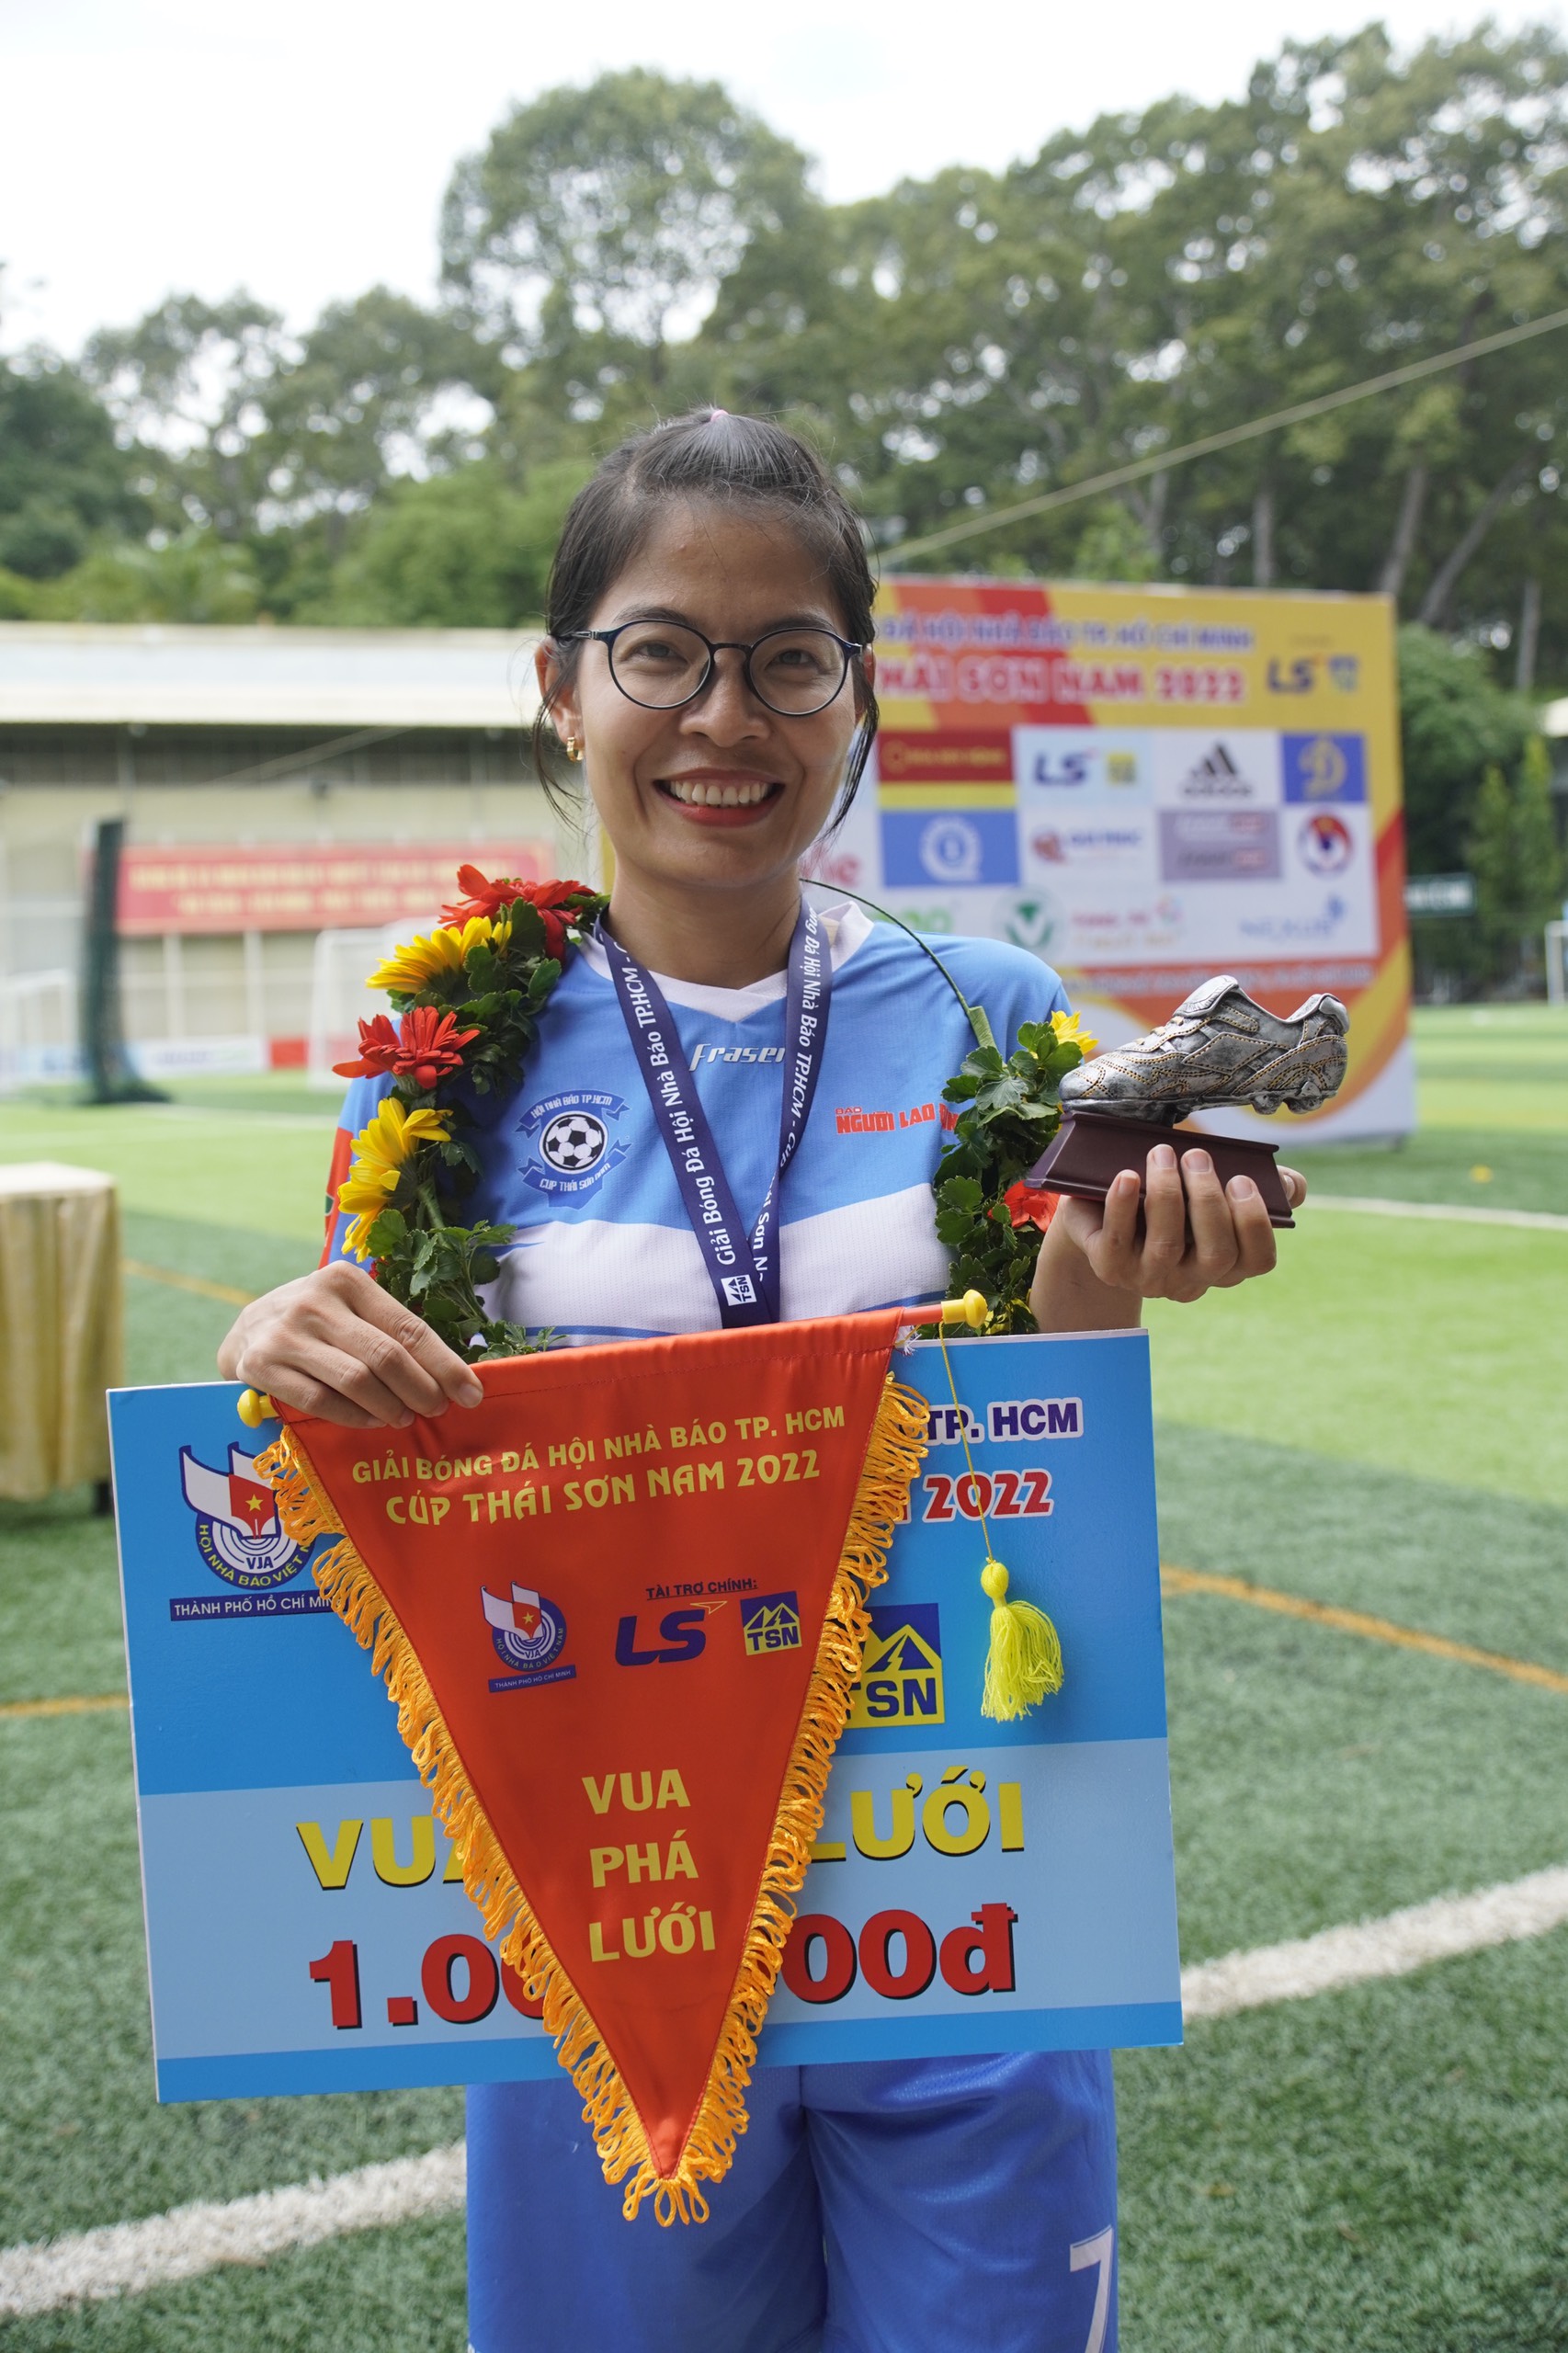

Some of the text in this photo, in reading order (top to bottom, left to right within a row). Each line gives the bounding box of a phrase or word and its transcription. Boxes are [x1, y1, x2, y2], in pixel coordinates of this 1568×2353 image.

[876, 654, 950, 698] HÁI
[804, 935, 820, 955] Đá
[800, 956, 821, 977] Hội
[621, 967, 656, 1029] TP.HCM
[802, 979, 821, 1010] Nhà
[647, 1031, 670, 1066] Báo
[799, 1014, 817, 1047] Báo
[656, 1070, 683, 1107] Nhà
[791, 1051, 812, 1119] TP.HCM
[669, 1110, 695, 1142] Hội
[899, 1103, 936, 1129] LAO
[681, 1146, 705, 1173] Đá
[696, 1176, 723, 1224] Bóng
[709, 1228, 736, 1265] Giải
[736, 1276, 752, 1302] TSN
[926, 1403, 1078, 1440] TP. HCM
[352, 1405, 846, 1483] GIẢI BÓNG ĐÁ HỘI NHÀ BÁO TP. HCM
[386, 1449, 820, 1526] CÚP THÁI SƠN NAM 2022
[926, 1472, 1051, 1520] 2022
[199, 1524, 212, 1553] HỘI
[272, 1554, 302, 1581] VIỆT
[245, 1556, 274, 1570] VJA
[175, 1598, 221, 1616] THÀNH
[225, 1596, 252, 1613] PHỐ
[256, 1594, 276, 1610] HỒ
[280, 1594, 305, 1609] CHÍ
[646, 1578, 757, 1598] TÀI TRỢ CHÍNH:
[524, 1650, 542, 1659] VJA
[615, 1608, 707, 1666] LS
[747, 1625, 800, 1652] TSN
[582, 1768, 691, 1814] VUA
[589, 1829, 699, 1888] PHÁ
[589, 1901, 716, 1962] LƯỚI
[1070, 2224, 1114, 2352] 7
